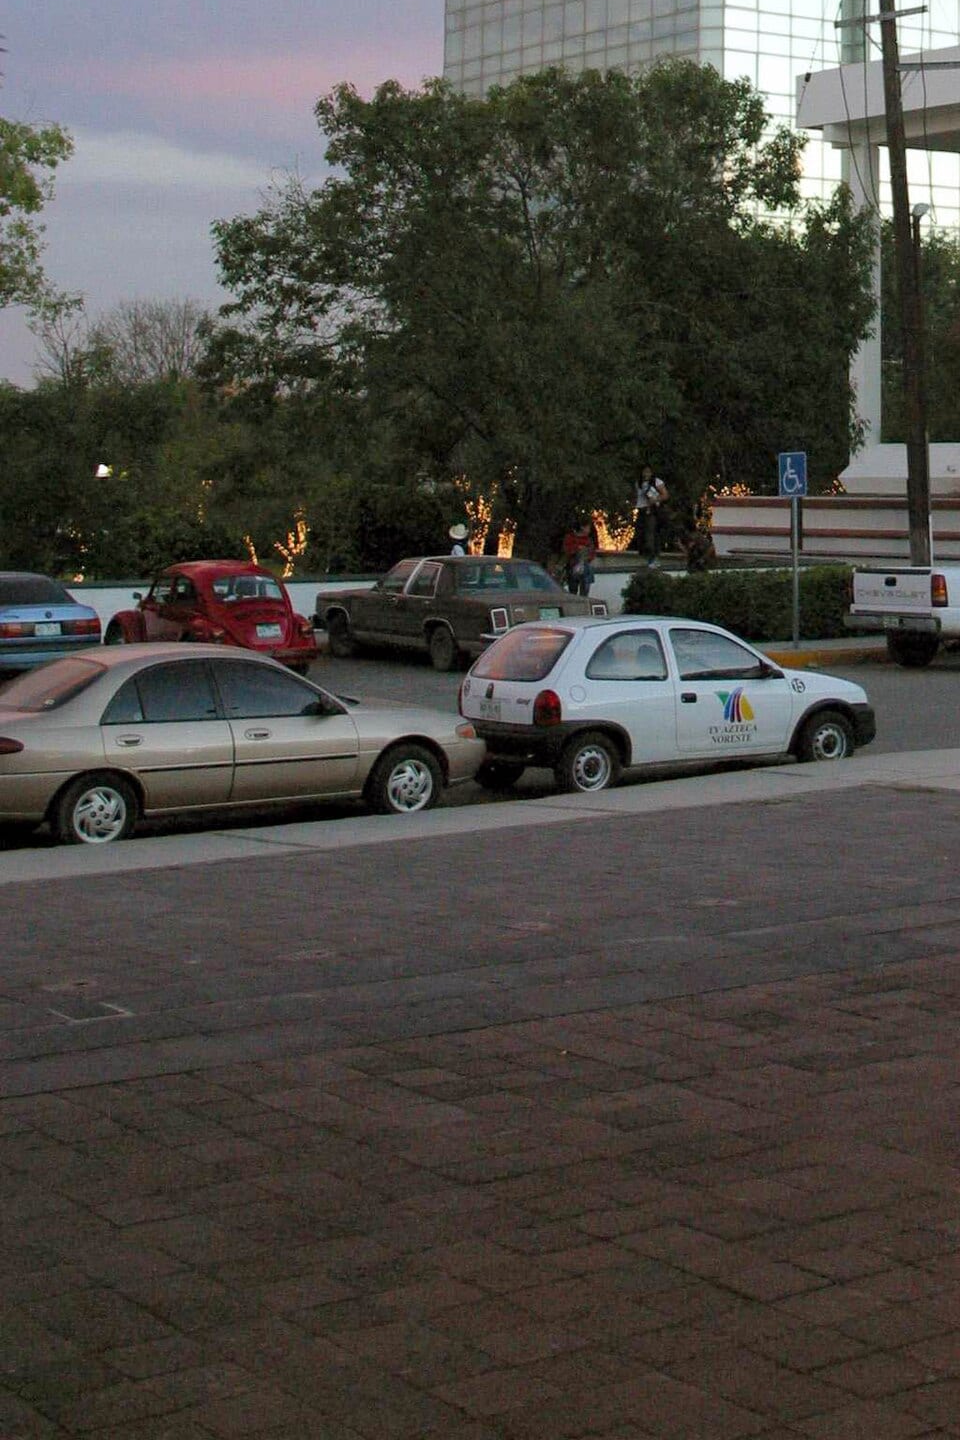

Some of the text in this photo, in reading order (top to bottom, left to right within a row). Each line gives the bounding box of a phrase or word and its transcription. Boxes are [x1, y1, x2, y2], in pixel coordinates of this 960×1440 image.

[708, 723, 758, 735] TV AZTECA
[711, 733, 752, 743] NORESTE
